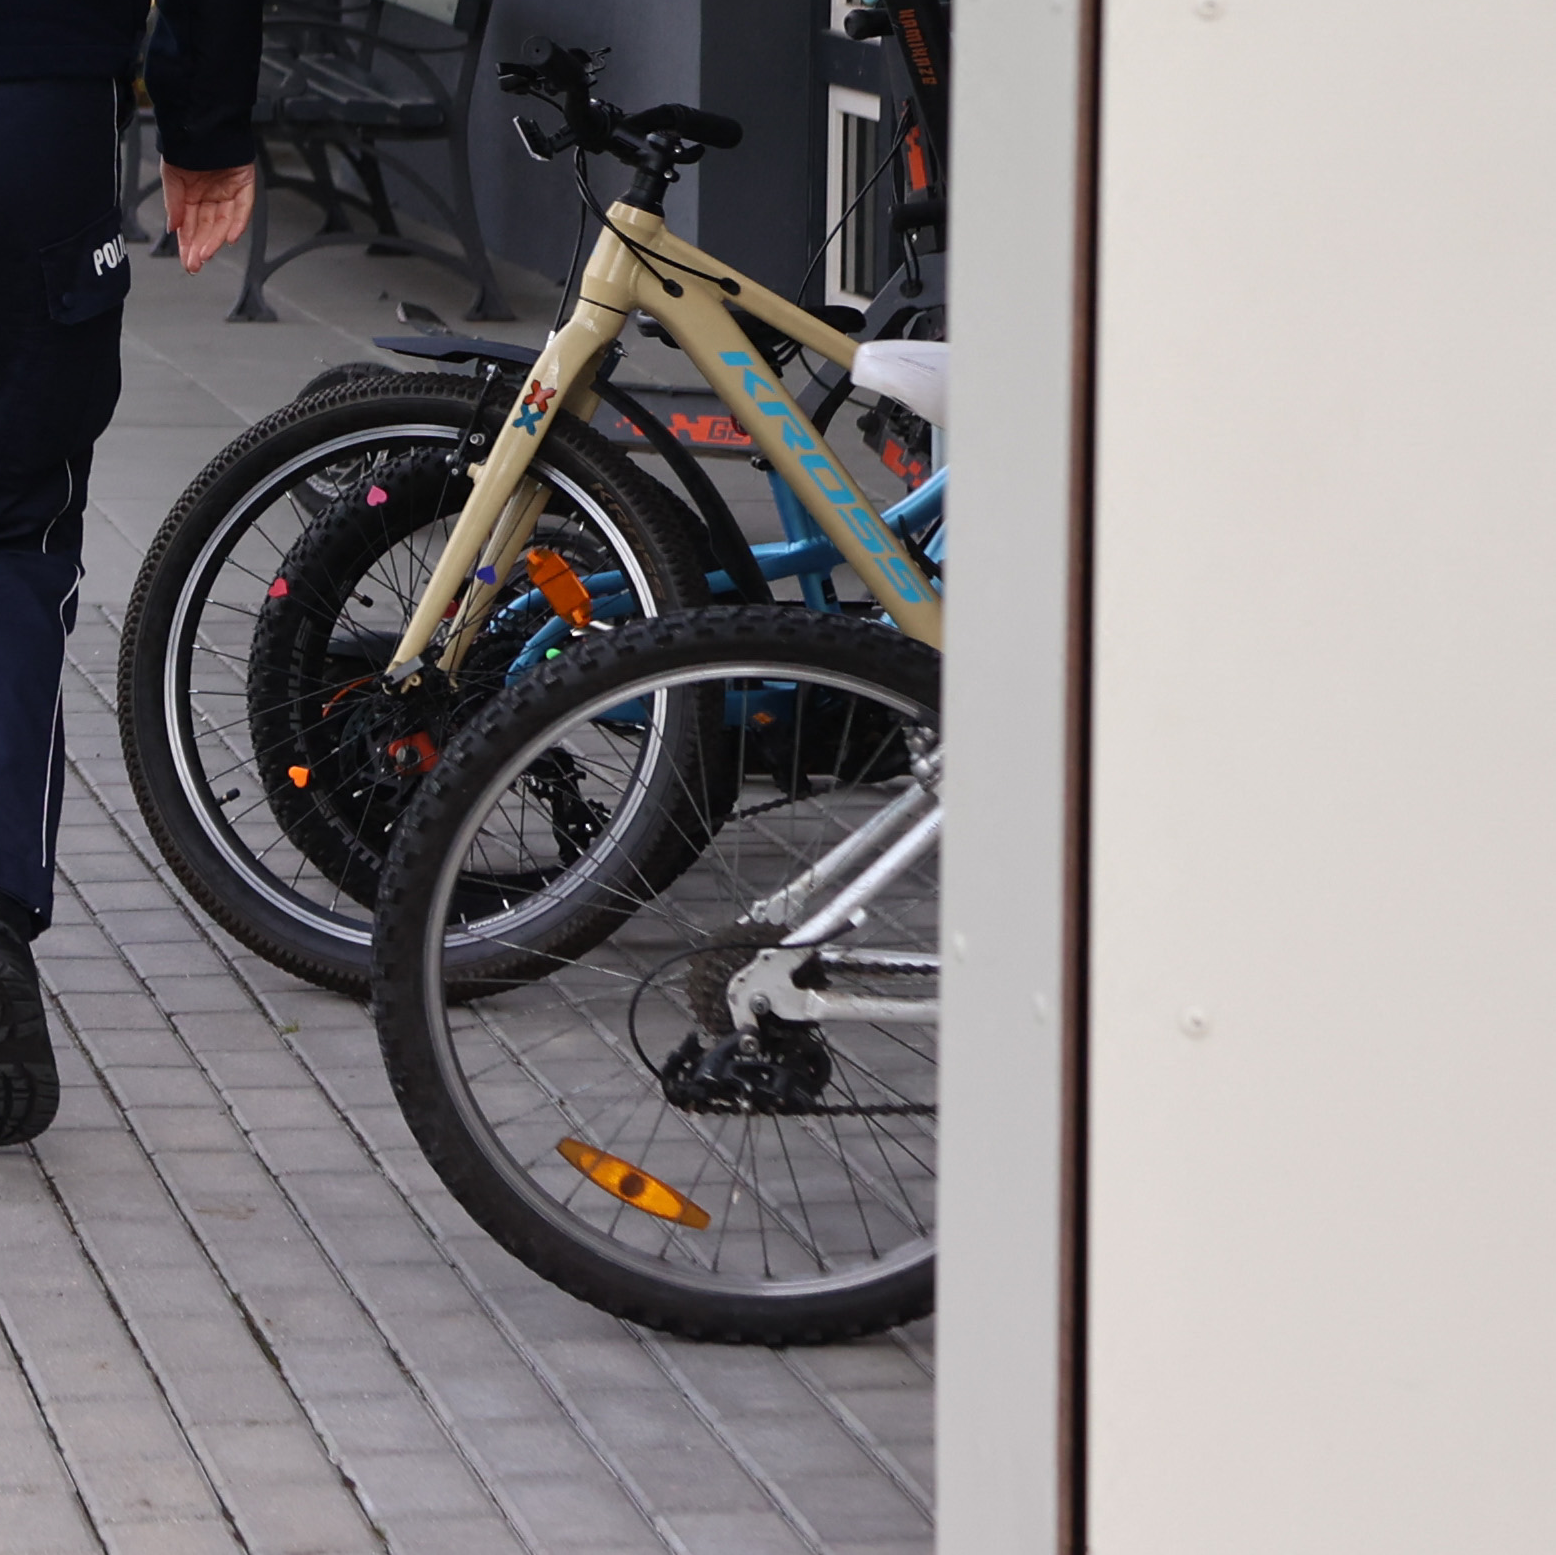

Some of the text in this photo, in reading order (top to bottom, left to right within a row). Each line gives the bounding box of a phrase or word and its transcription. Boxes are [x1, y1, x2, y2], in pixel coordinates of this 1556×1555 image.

[93, 233, 127, 276] POLI
[718, 350, 933, 604] KROSS
[288, 614, 317, 778] SMAR
